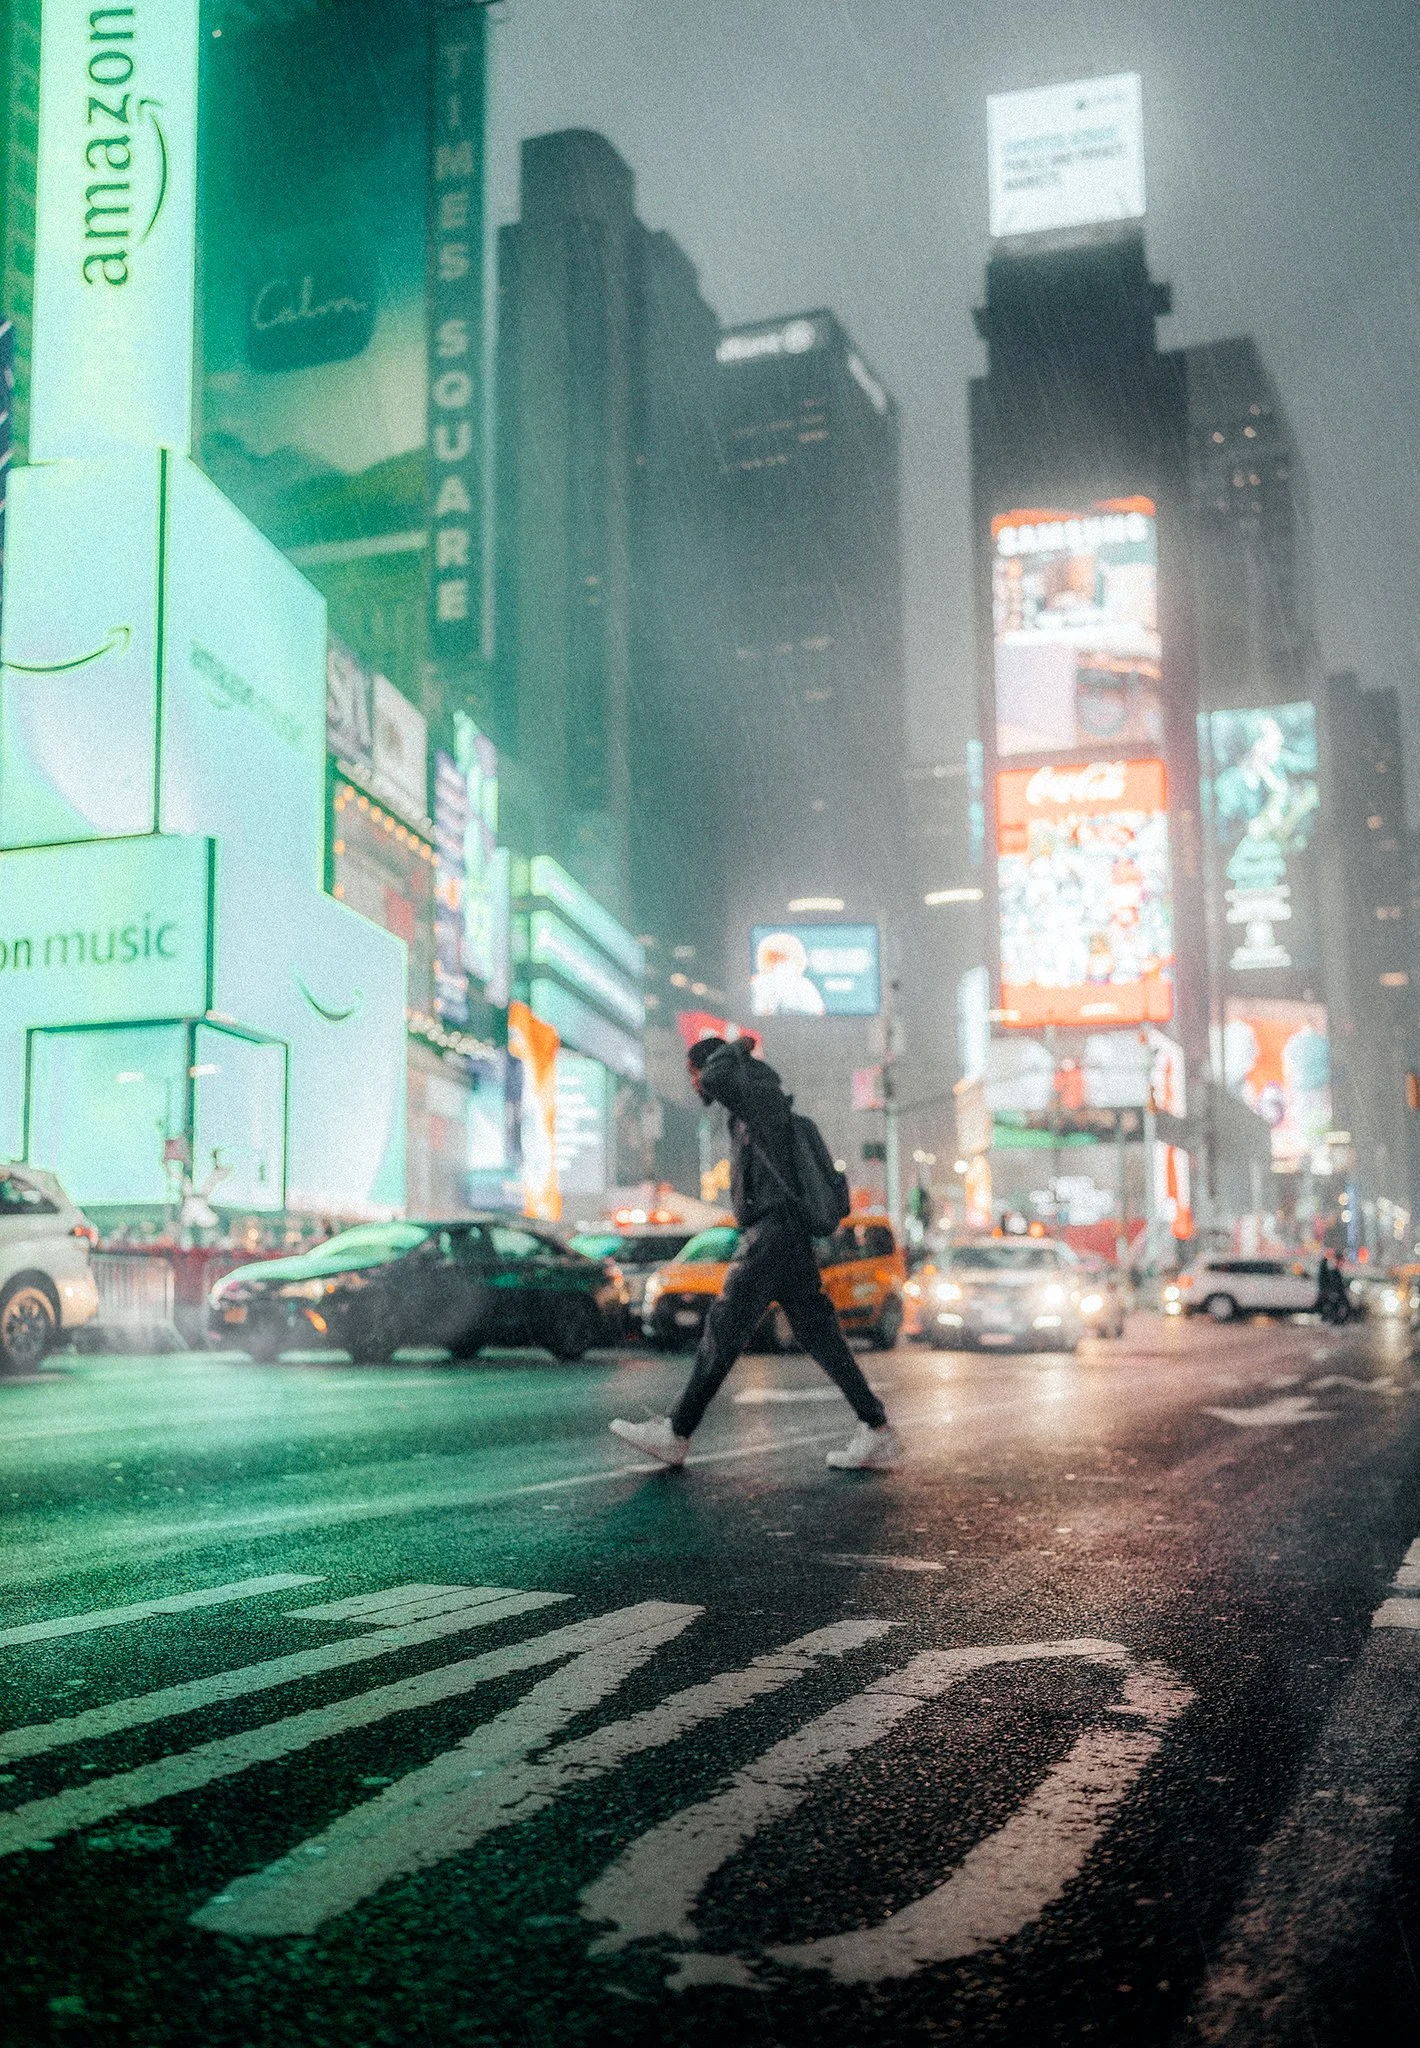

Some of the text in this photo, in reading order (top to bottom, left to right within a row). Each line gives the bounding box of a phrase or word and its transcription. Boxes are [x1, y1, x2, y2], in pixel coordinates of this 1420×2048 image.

[83, 8, 134, 286] amazon
[253, 276, 367, 330] Calm
[434, 42, 475, 622] TIMES SQUARE
[45, 911, 176, 966] music
